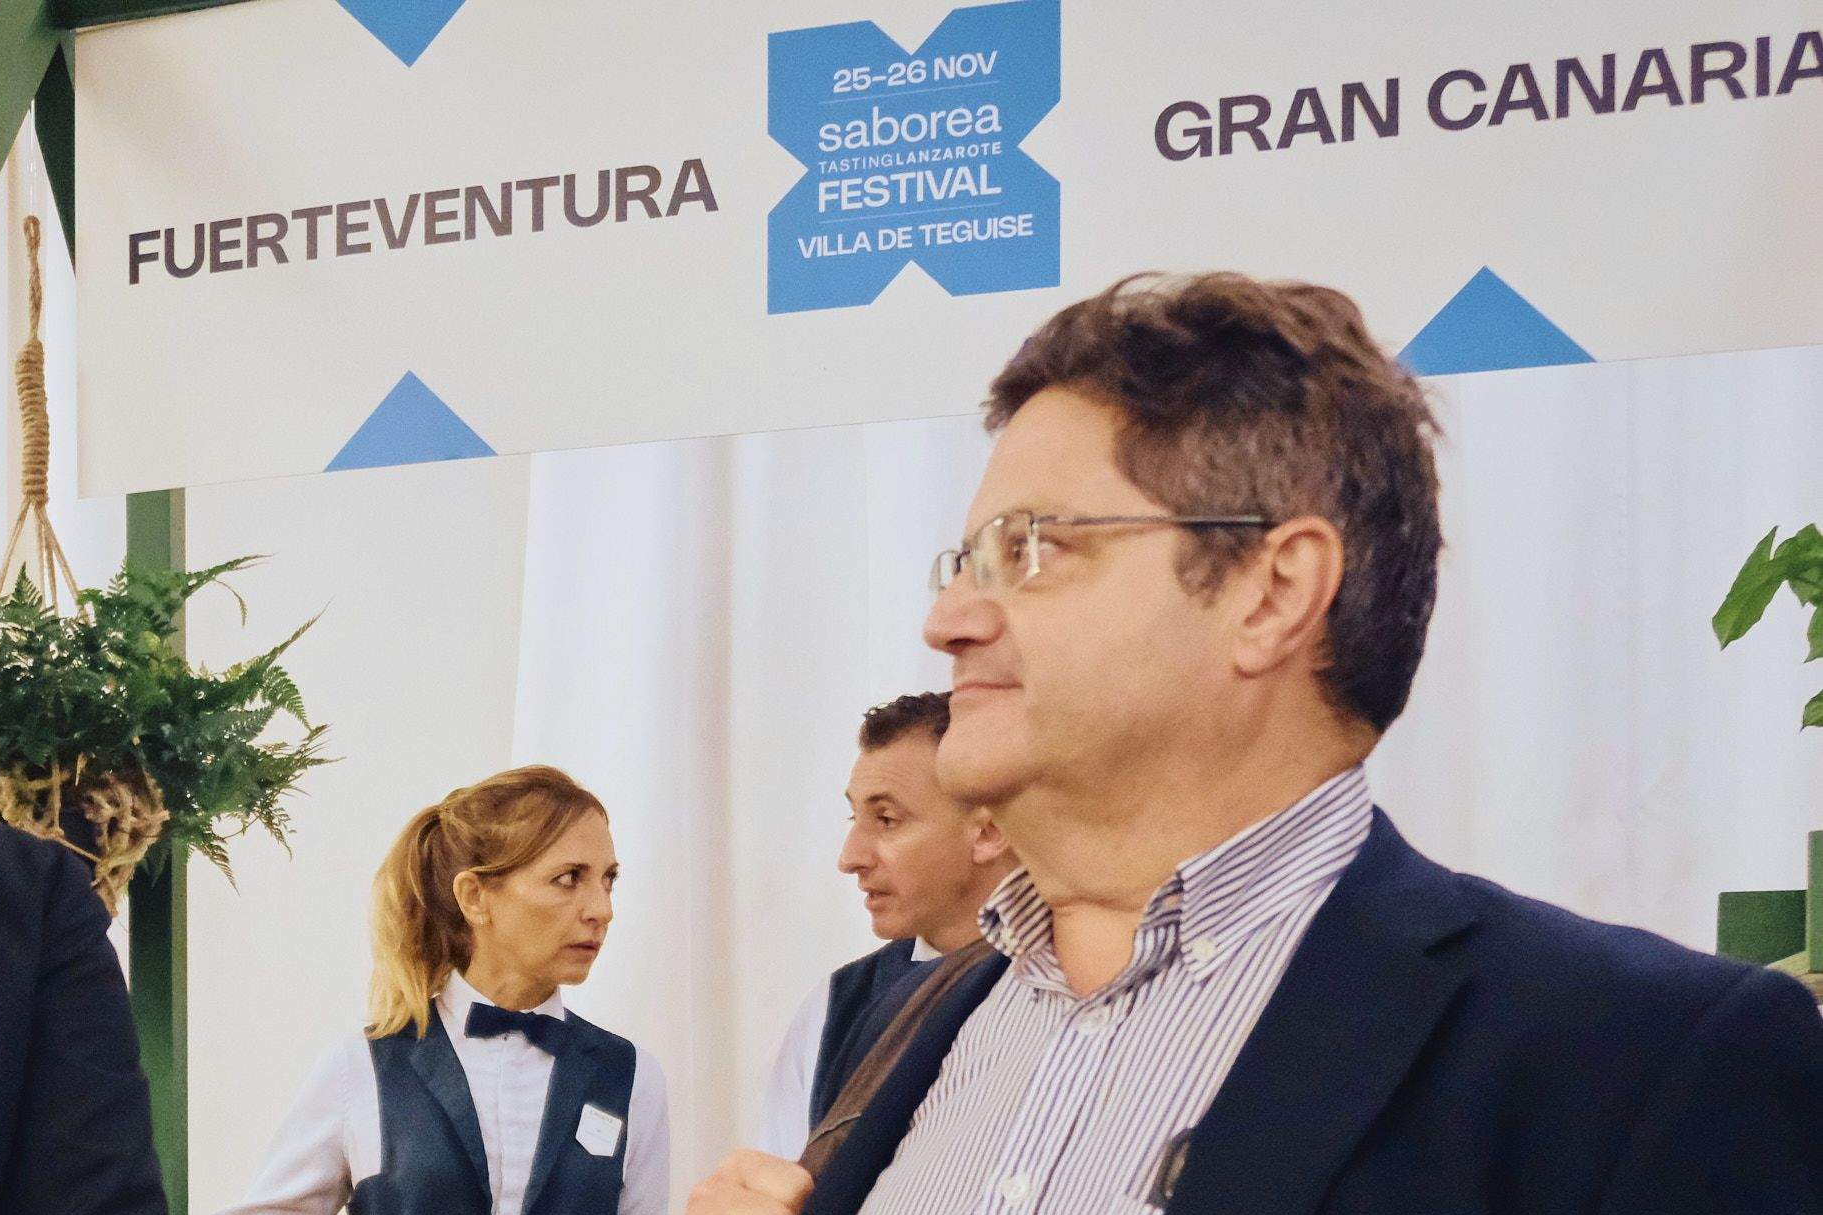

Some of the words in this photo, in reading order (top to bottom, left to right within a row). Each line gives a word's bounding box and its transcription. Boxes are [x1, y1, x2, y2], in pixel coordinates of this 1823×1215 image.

[933, 50, 998, 81] NOV
[1154, 77, 1401, 162] GRAN
[1427, 31, 1823, 131] CANARIA
[818, 104, 1002, 152] saborea
[818, 164, 1003, 213] FESTIVAL
[128, 158, 719, 286] FUERTEVENTURA
[797, 234, 872, 259] VILLA
[877, 226, 914, 251] DE
[919, 213, 1034, 247] TEGUISE
